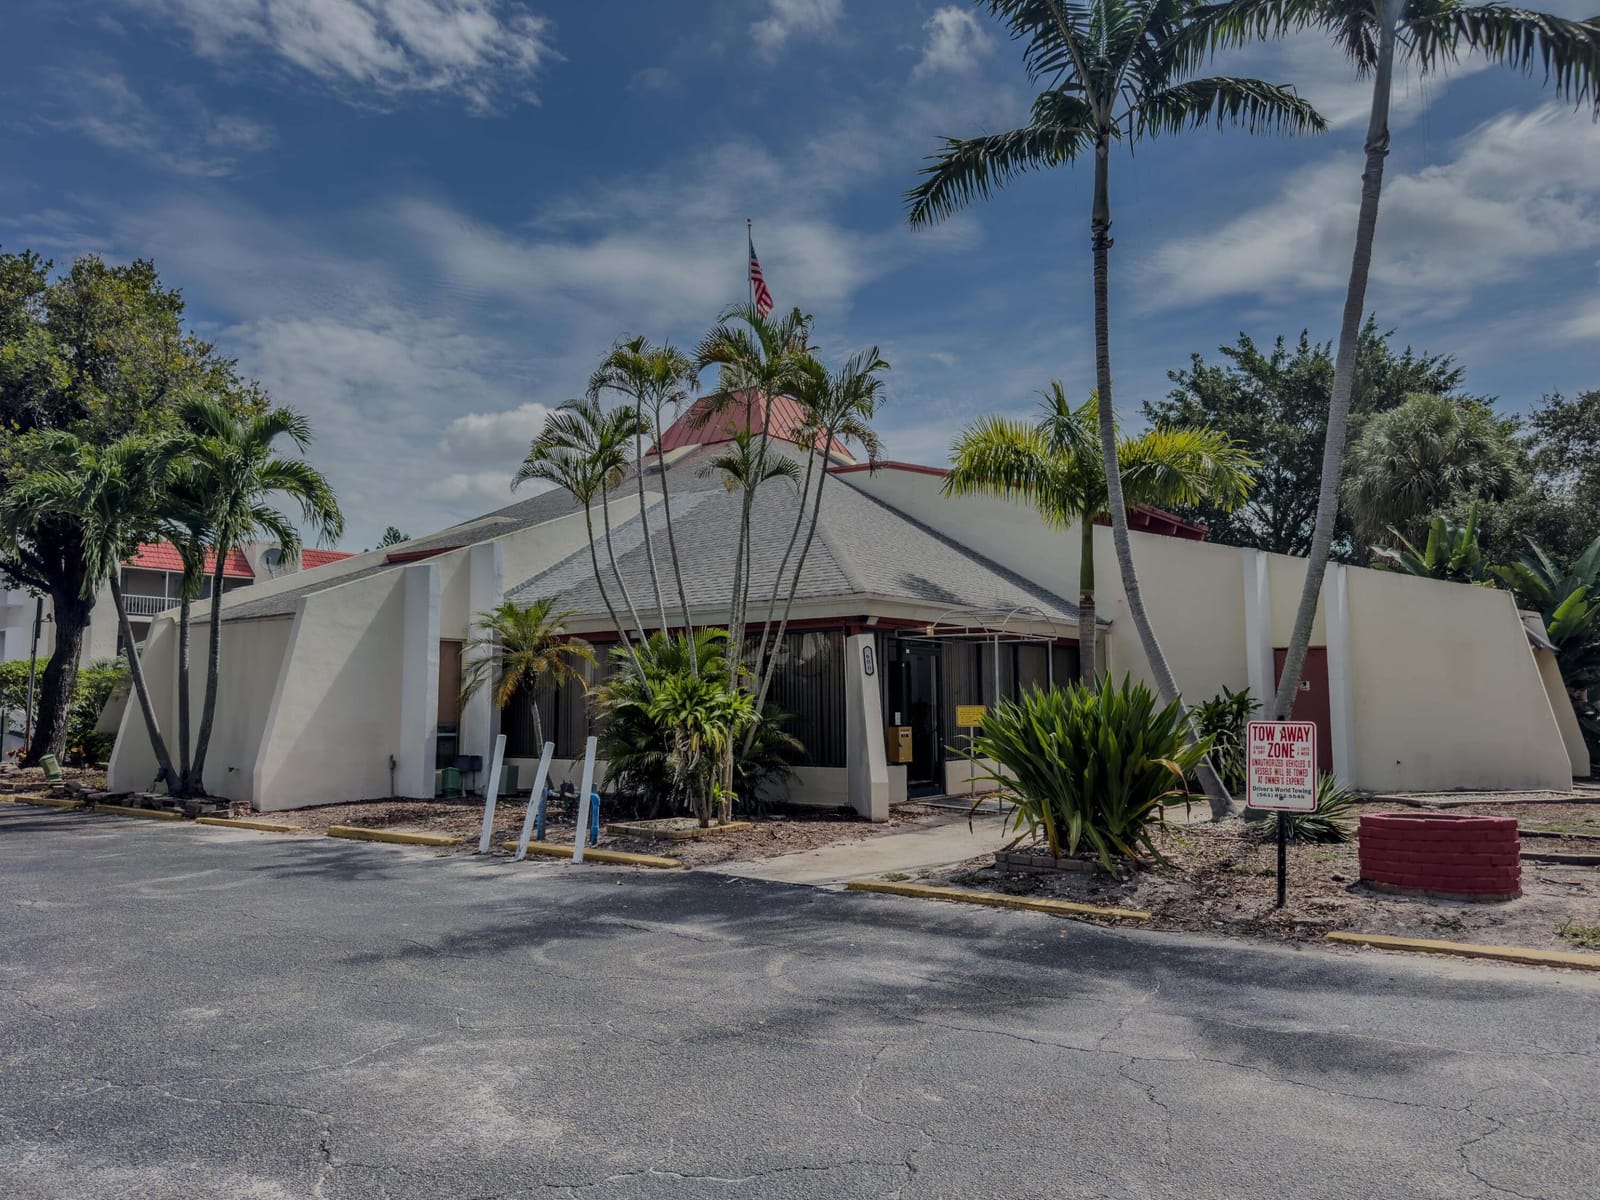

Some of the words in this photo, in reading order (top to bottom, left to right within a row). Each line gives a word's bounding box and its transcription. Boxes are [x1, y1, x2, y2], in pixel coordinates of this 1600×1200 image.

[1252, 726, 1275, 741] TOW
[1280, 726, 1311, 742] AWAY
[1267, 743, 1295, 758] ZONE
[1252, 759, 1283, 767] UNAUTHORIZED
[1286, 760, 1305, 768] VEHICLES
[1274, 768, 1284, 776] WILL
[1286, 768, 1292, 776] BE
[1294, 768, 1308, 777] TOWED
[1286, 777, 1305, 786] EXPENSE
